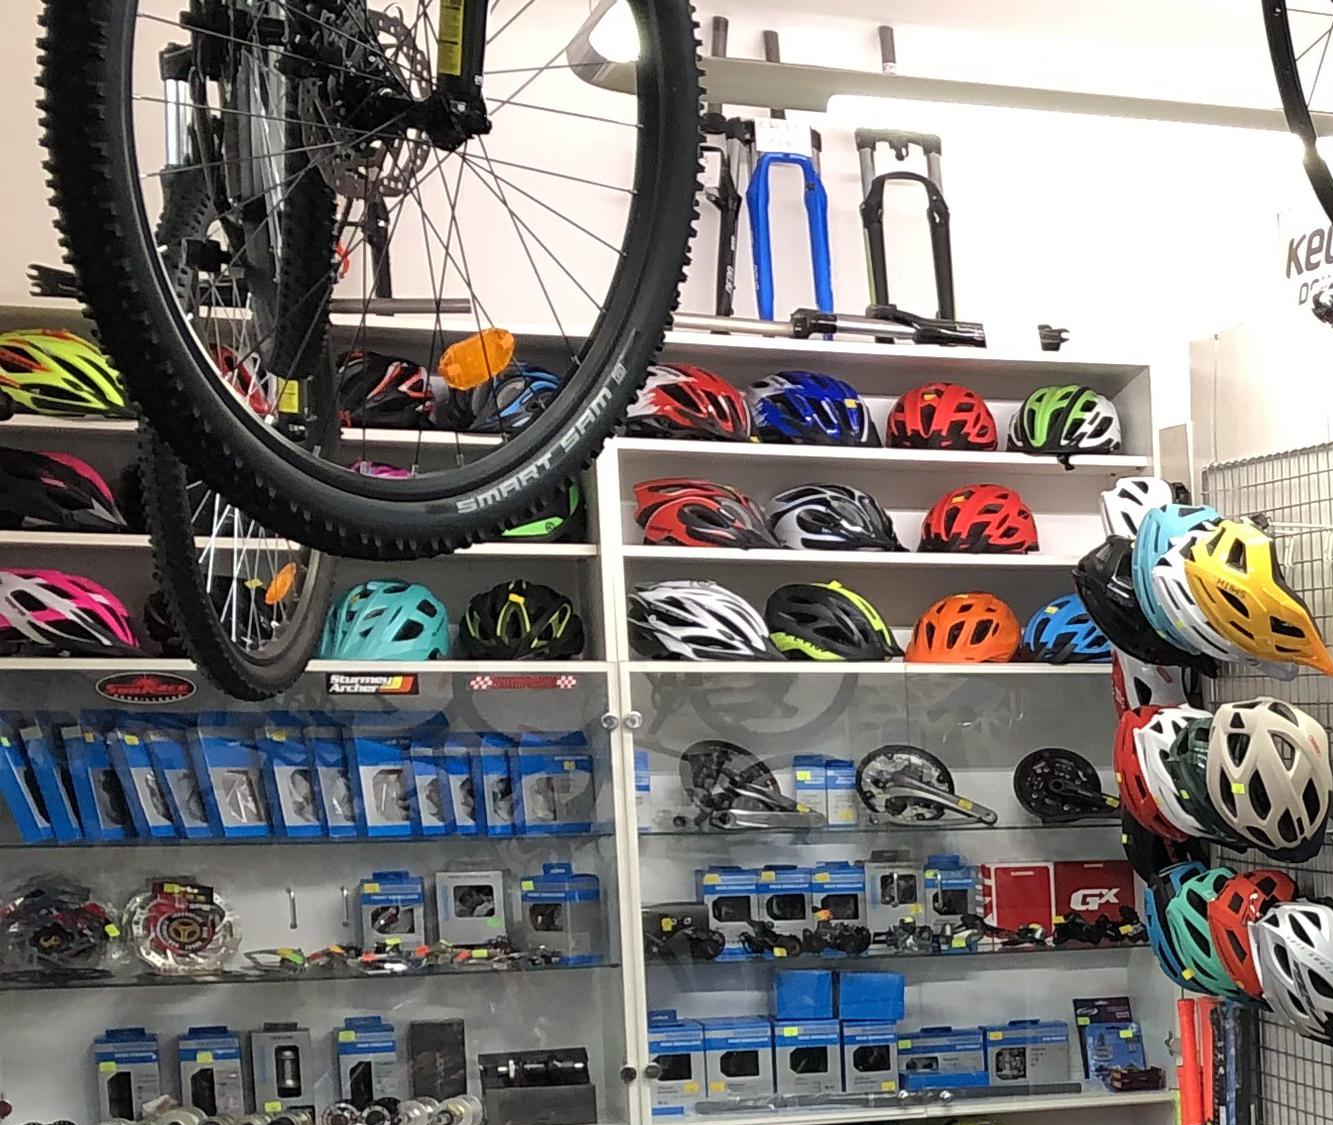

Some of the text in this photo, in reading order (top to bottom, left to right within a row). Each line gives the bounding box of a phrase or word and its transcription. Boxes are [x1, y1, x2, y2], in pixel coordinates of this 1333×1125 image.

[456, 387, 614, 515] SMART SAM
[329, 683, 380, 693] Archer
[330, 674, 393, 685] Sturmey
[1070, 887, 1121, 911] GX
